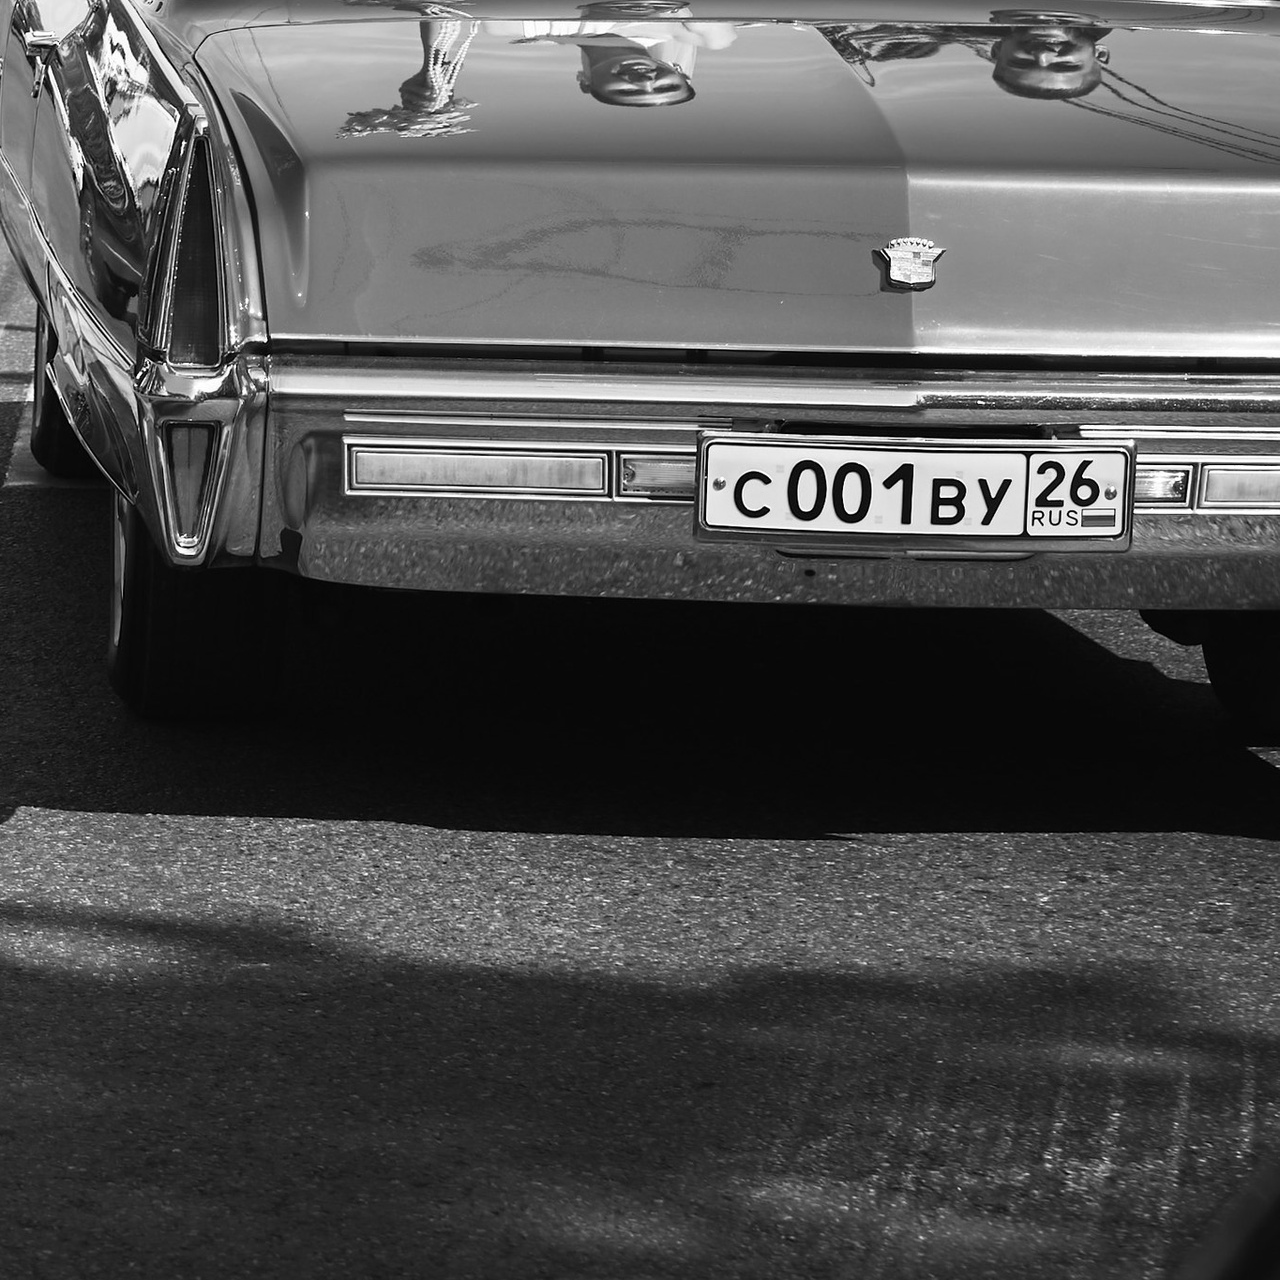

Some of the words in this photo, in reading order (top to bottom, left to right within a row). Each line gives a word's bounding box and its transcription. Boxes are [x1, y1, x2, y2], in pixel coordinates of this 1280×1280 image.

[732, 458, 1014, 526] С001ВУ
[1034, 459, 1101, 508] 26
[1030, 509, 1079, 527] RUS
